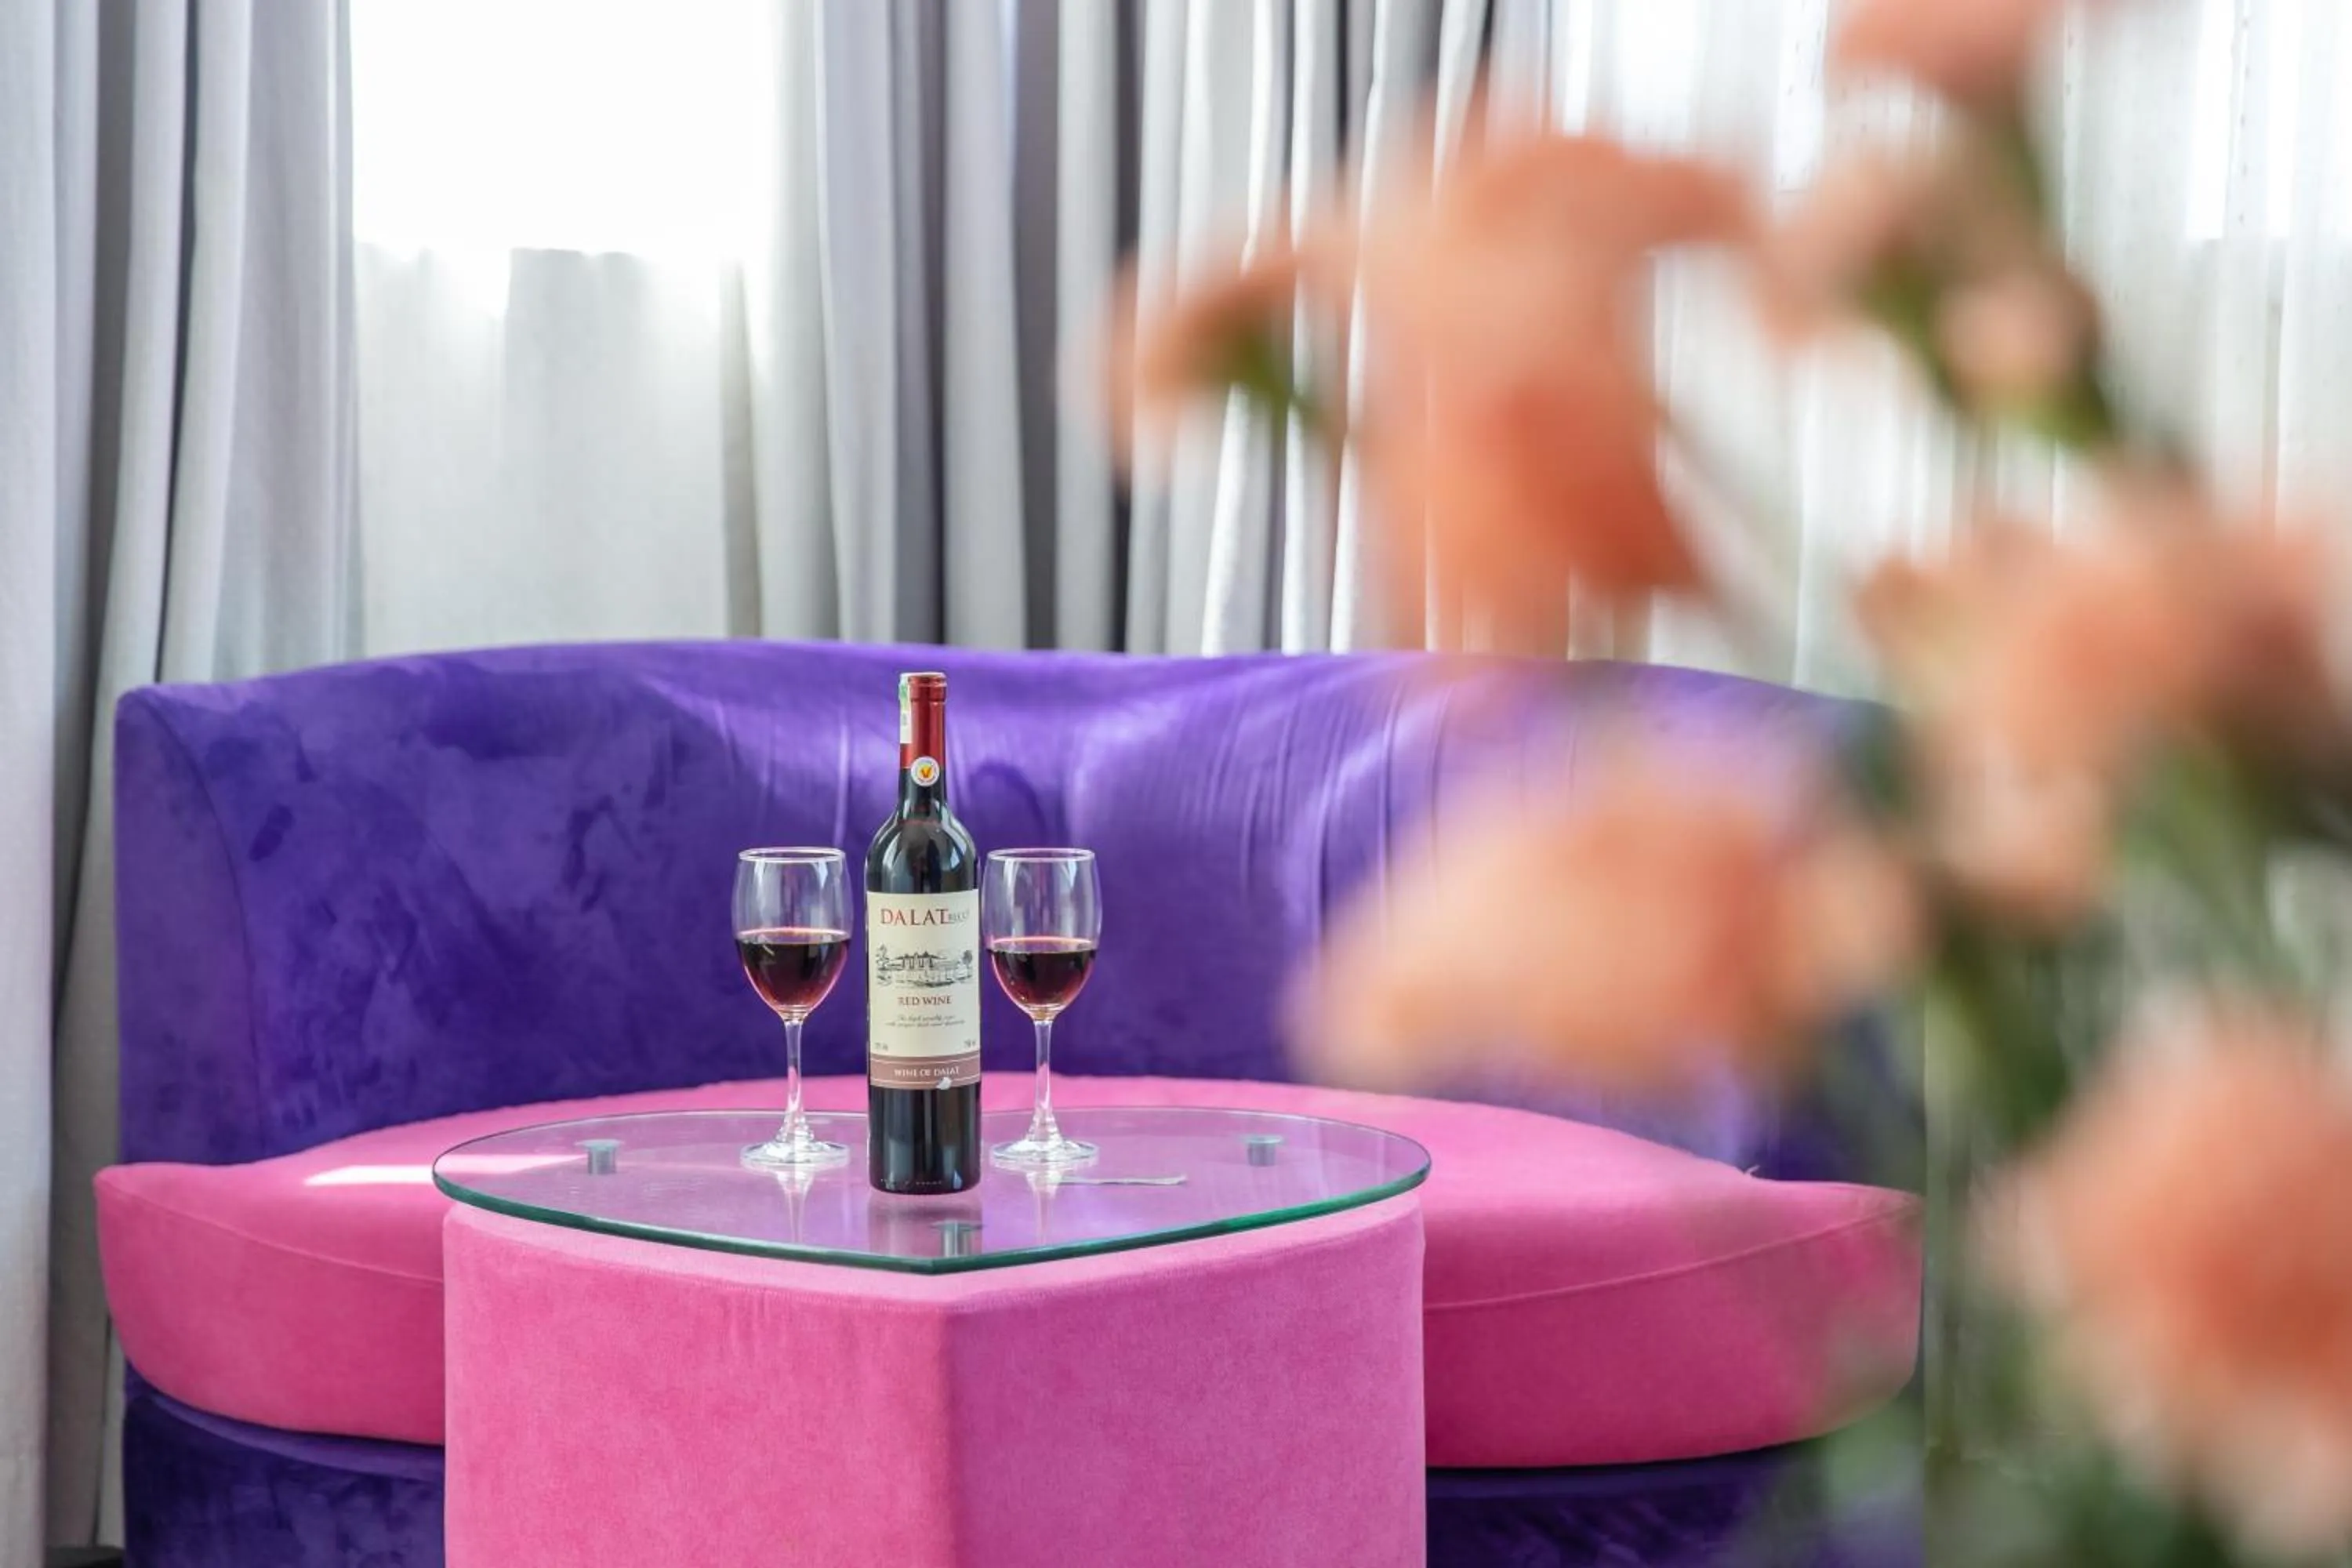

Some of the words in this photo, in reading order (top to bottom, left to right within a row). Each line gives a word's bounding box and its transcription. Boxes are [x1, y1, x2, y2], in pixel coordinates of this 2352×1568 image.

[881, 909, 949, 925] DALAT
[898, 996, 920, 1006] RED
[923, 996, 952, 1006] WINE
